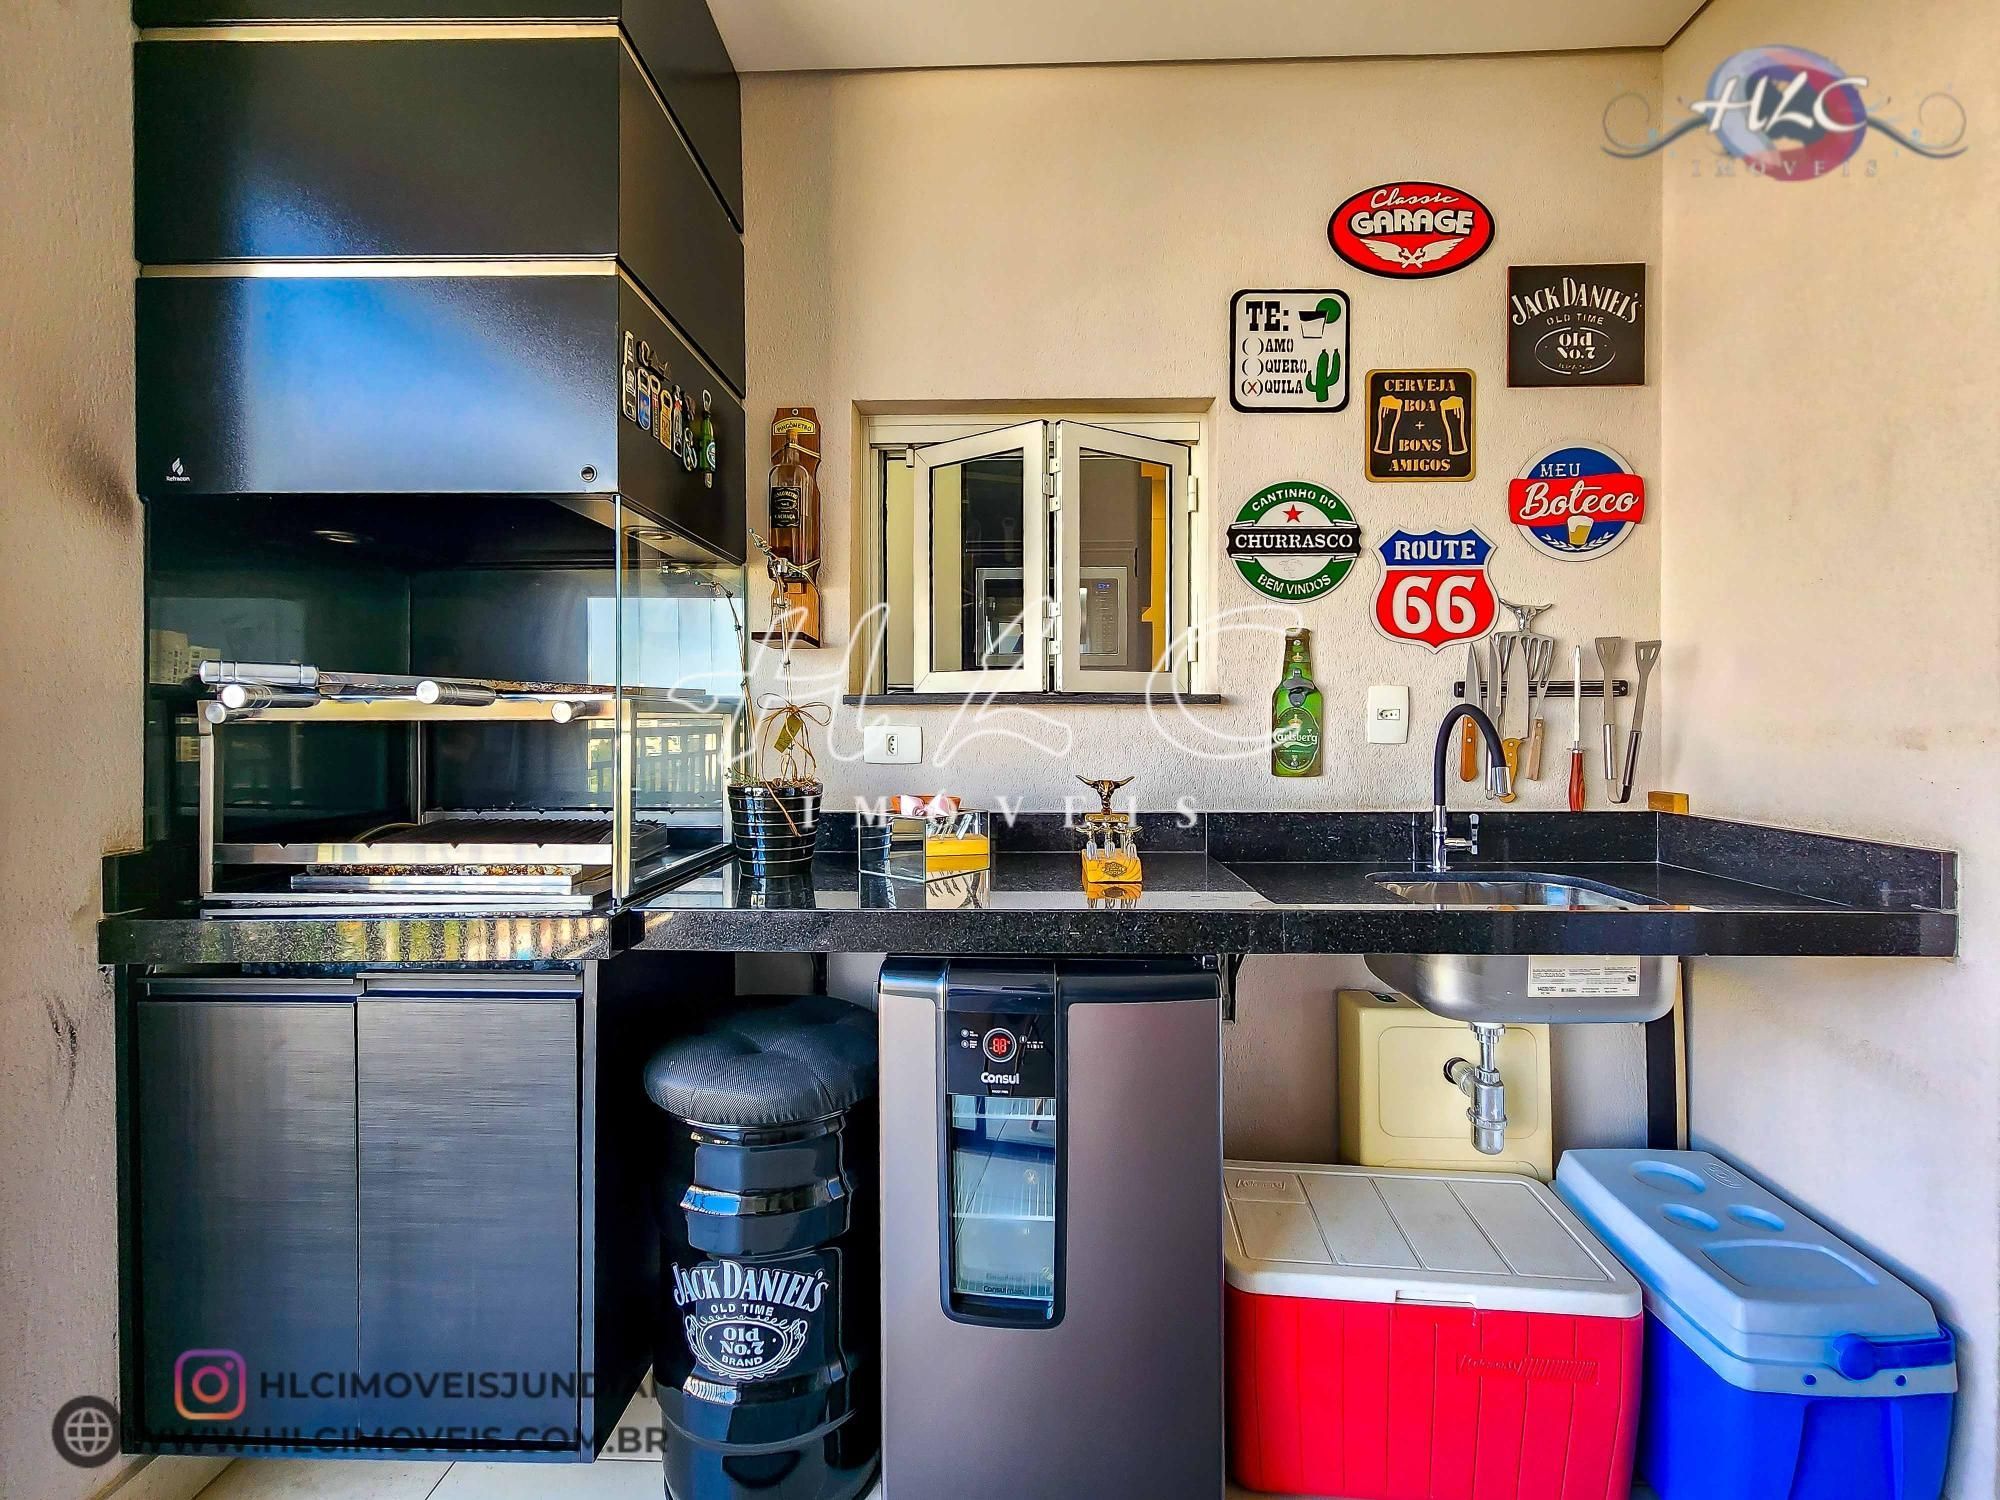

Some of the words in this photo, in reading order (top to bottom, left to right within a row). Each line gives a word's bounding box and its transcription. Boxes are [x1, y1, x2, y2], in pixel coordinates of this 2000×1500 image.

[1371, 187, 1459, 208] Classic
[1350, 208, 1473, 235] GARAGE
[1511, 286, 1561, 326] JACK
[1562, 277, 1643, 324] DANIEL'S
[1245, 300, 1289, 332] TE:
[1546, 313, 1571, 326] OLD
[1576, 312, 1604, 325] TIME
[1265, 338, 1294, 353] AMO
[1265, 359, 1307, 374] QUERO
[1264, 379, 1304, 394] QUILA
[1384, 378, 1456, 392] CERVEJA
[1404, 399, 1437, 412] BOA
[1398, 438, 1442, 452] BONS
[1388, 458, 1451, 472] AMIGOS
[1540, 463, 1581, 477] MEU
[1251, 488, 1317, 511] CANTINHO
[1318, 494, 1337, 509] DO
[1519, 479, 1640, 520] Boteco
[1234, 534, 1354, 549] CHURRASCO
[1394, 539, 1477, 561] ROUTE
[1257, 573, 1285, 594] BEM
[1285, 574, 1332, 595] VINDOS
[1392, 574, 1478, 635] 66
[1272, 727, 1318, 745] Carlsberg
[980, 1071, 1020, 1085] Consul
[672, 1262, 721, 1307] JACK
[720, 1261, 829, 1313] DANIEL'S
[710, 1303, 737, 1314] OLD
[741, 1303, 775, 1317] TIME
[723, 1327, 760, 1342] Old
[719, 1340, 764, 1356] No.7
[721, 1355, 764, 1368] BRAND
